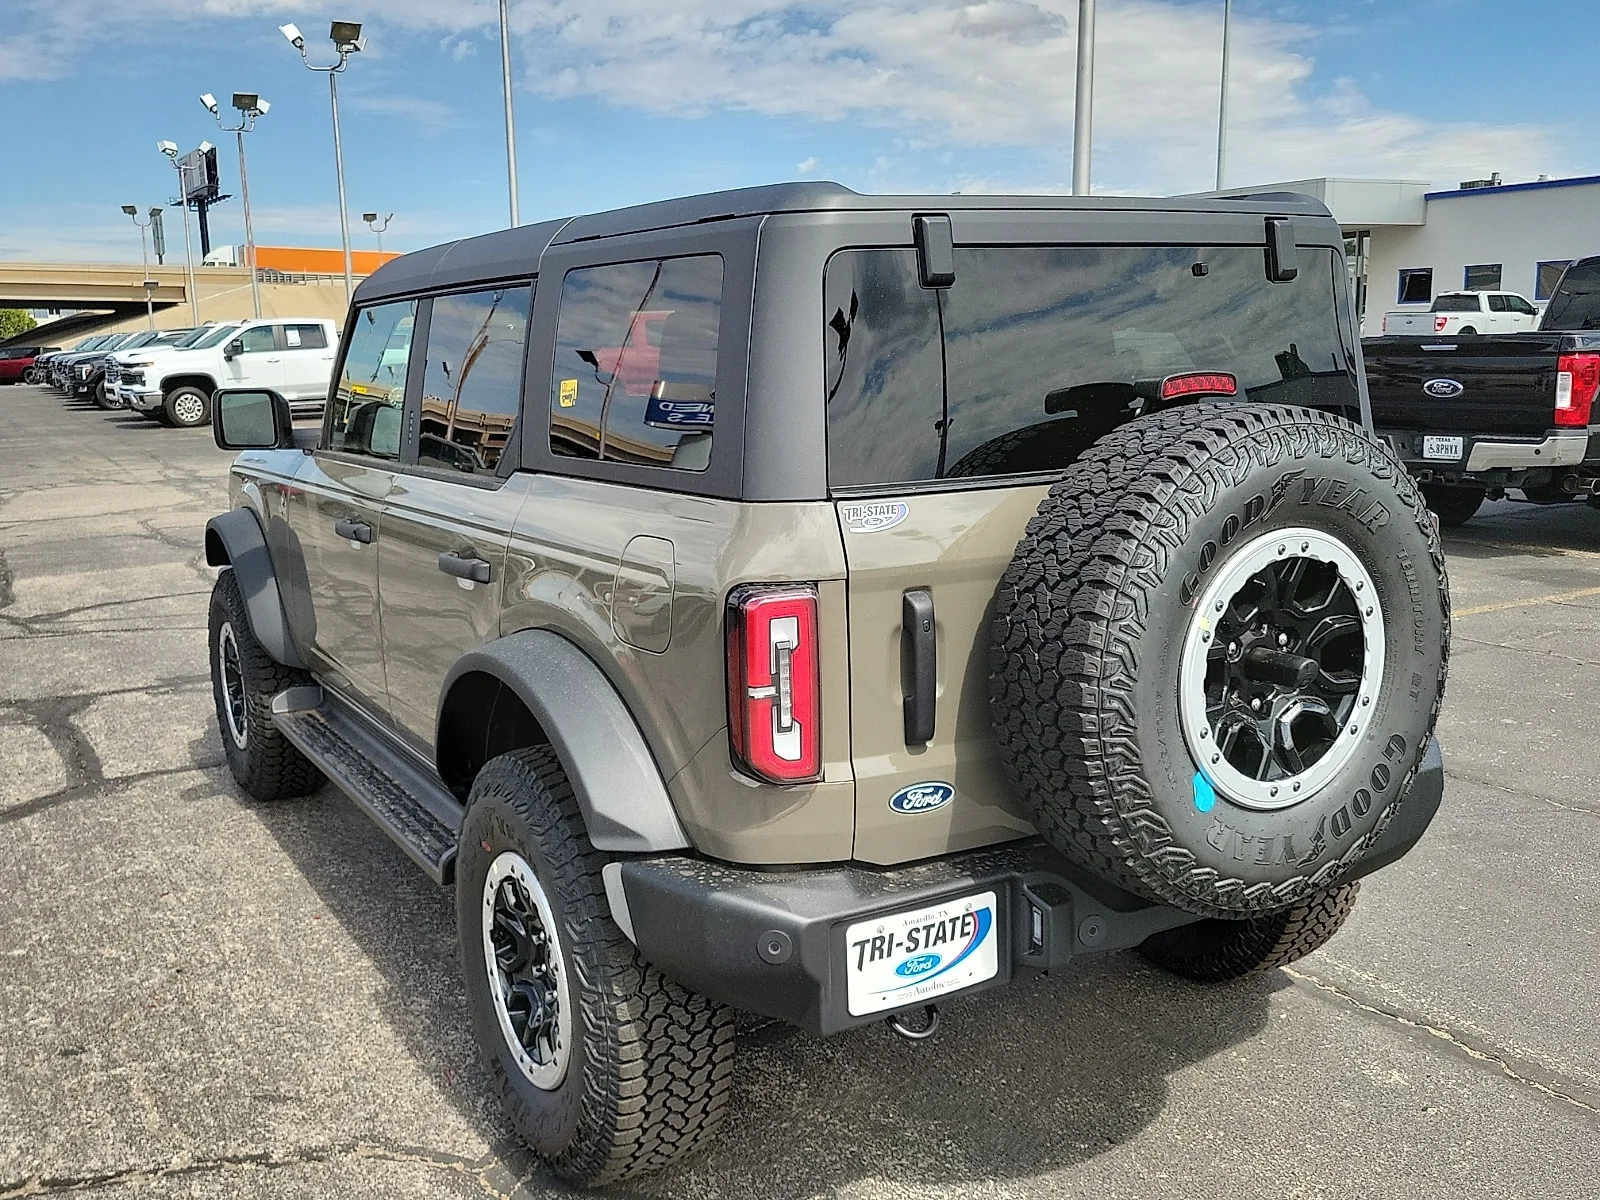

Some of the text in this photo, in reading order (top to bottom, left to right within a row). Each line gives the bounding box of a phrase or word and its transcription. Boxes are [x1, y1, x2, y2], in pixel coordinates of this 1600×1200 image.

[1431, 382, 1454, 393] Ford
[844, 504, 897, 521] TRI-STATE
[1397, 548, 1425, 656] TERRITORY
[902, 787, 944, 810] Ford
[938, 910, 948, 919] TX
[852, 912, 973, 973] TRI-STATE
[904, 957, 934, 975] Ford
